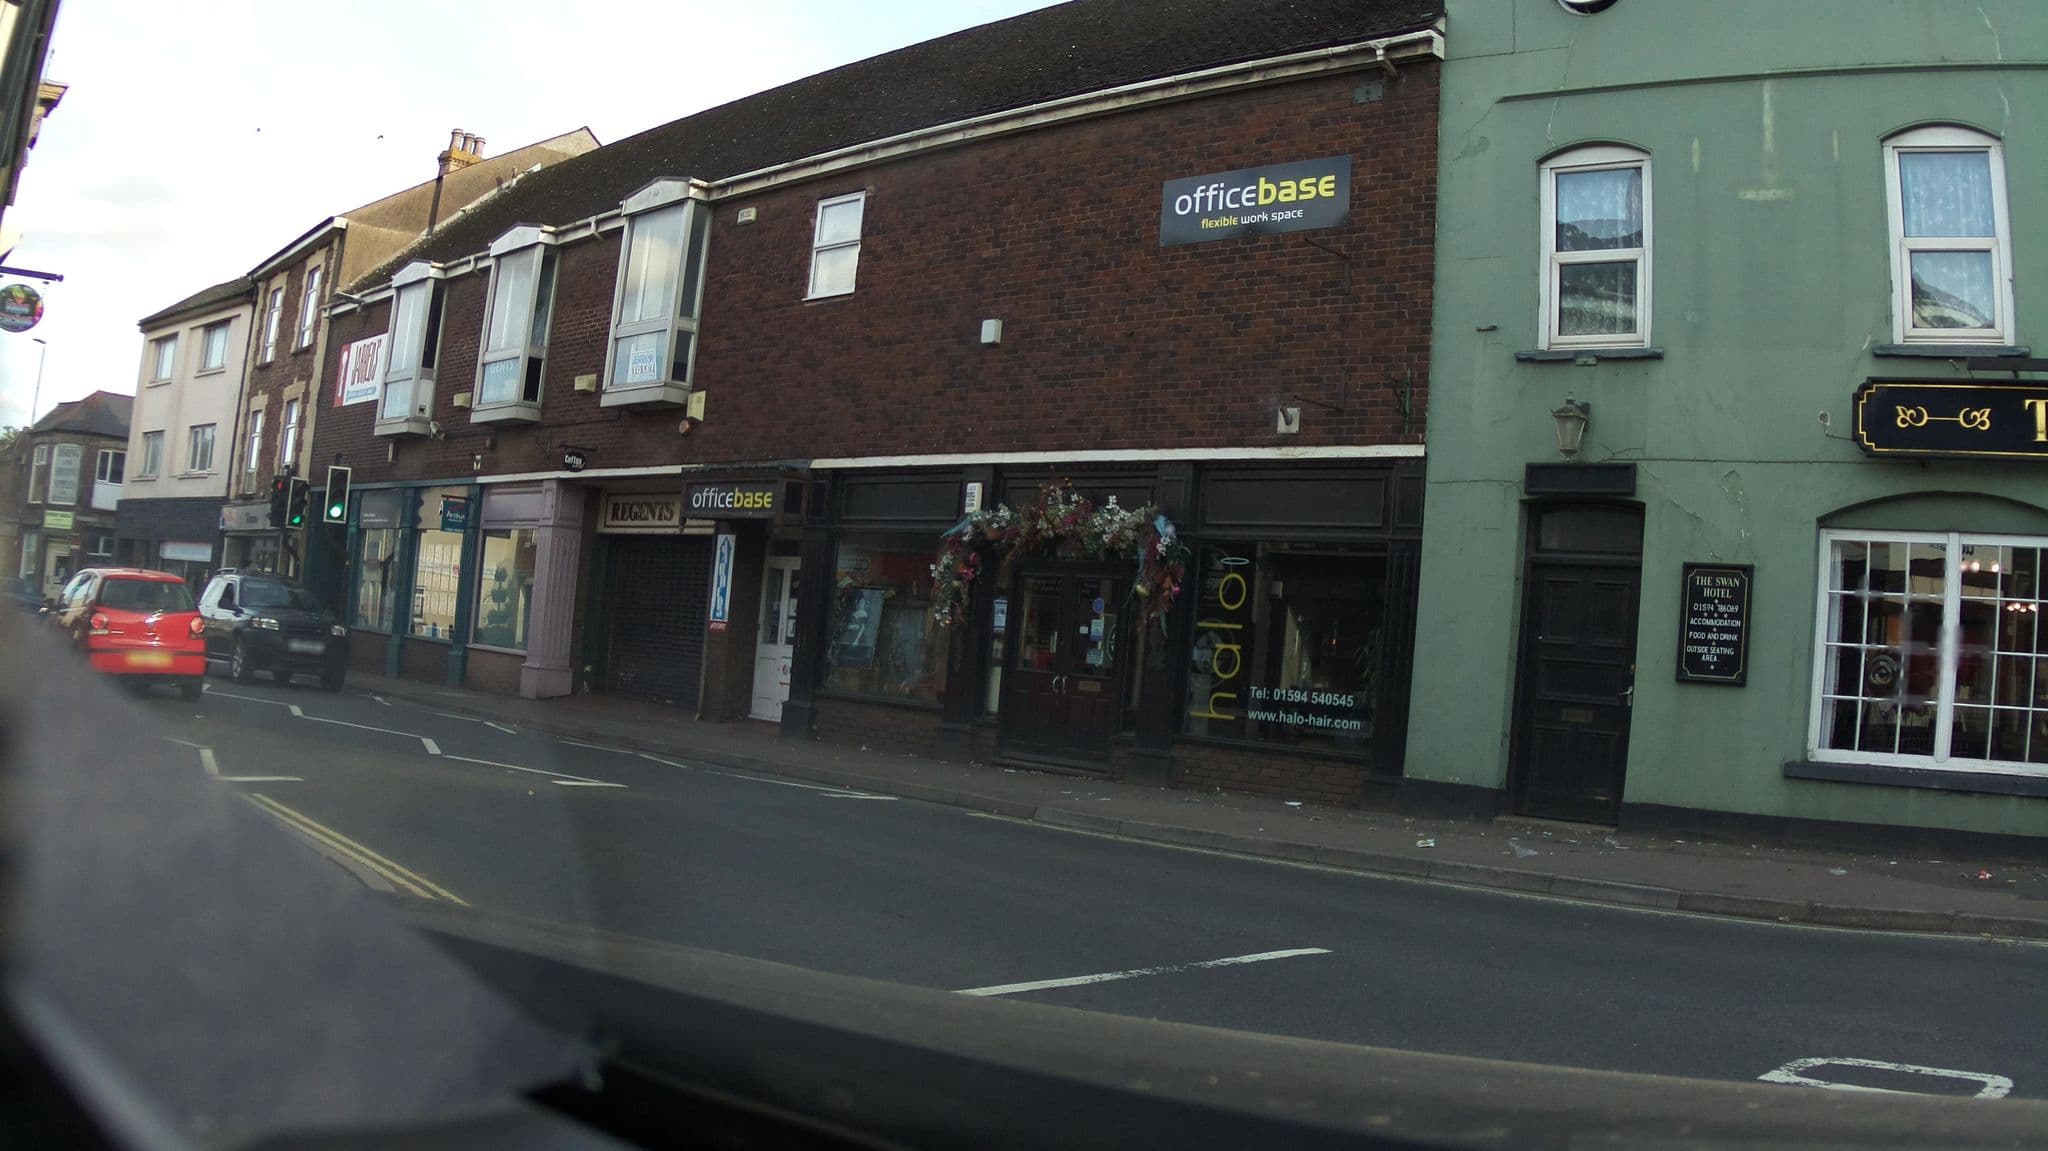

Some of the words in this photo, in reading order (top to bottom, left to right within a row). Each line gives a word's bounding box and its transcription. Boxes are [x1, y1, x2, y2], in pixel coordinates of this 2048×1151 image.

[1175, 174, 1336, 216] officebase
[1200, 215, 1239, 230] flexible
[1240, 211, 1268, 224] work
[1271, 209, 1304, 223] space
[692, 487, 773, 508] officebase
[1695, 576, 1713, 586] THE
[1715, 577, 1740, 588] SWAN
[1703, 588, 1731, 598] HOTEL
[1690, 618, 1740, 627] ACCOMMODATION
[1689, 631, 1706, 640] FOOD
[1707, 632, 1719, 640] AND
[1720, 633, 1738, 642] DRINK
[1189, 573, 1247, 720] halo
[1686, 645, 1709, 653] OUTSIDE
[1710, 647, 1734, 655] SEATING
[1701, 654, 1717, 662] AREA
[1250, 686, 1270, 700] Tel:
[1273, 688, 1308, 703] 01594
[1311, 692, 1354, 707] 540545
[1248, 709, 1360, 730] www.halo-hair.com
